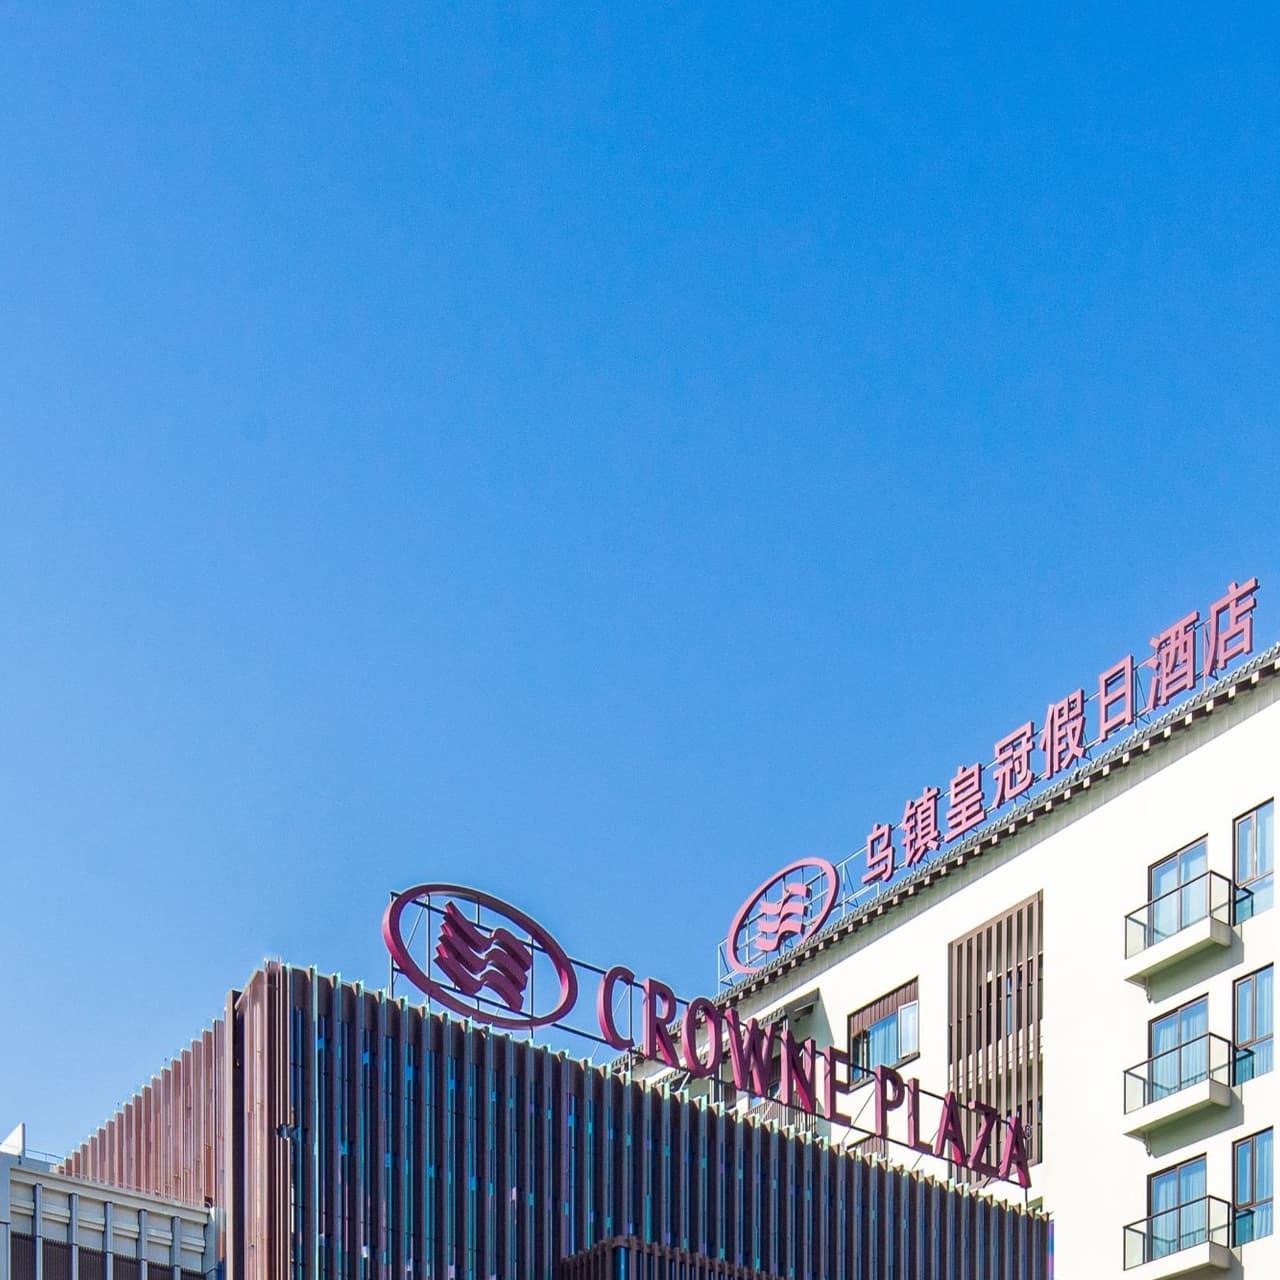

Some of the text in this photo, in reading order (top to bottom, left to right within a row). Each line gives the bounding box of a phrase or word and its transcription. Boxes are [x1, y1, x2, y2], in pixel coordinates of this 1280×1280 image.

[862, 577, 1259, 883] 乌镇皇冠假日酒店
[597, 966, 1032, 1188] CROWNE PLAZA
